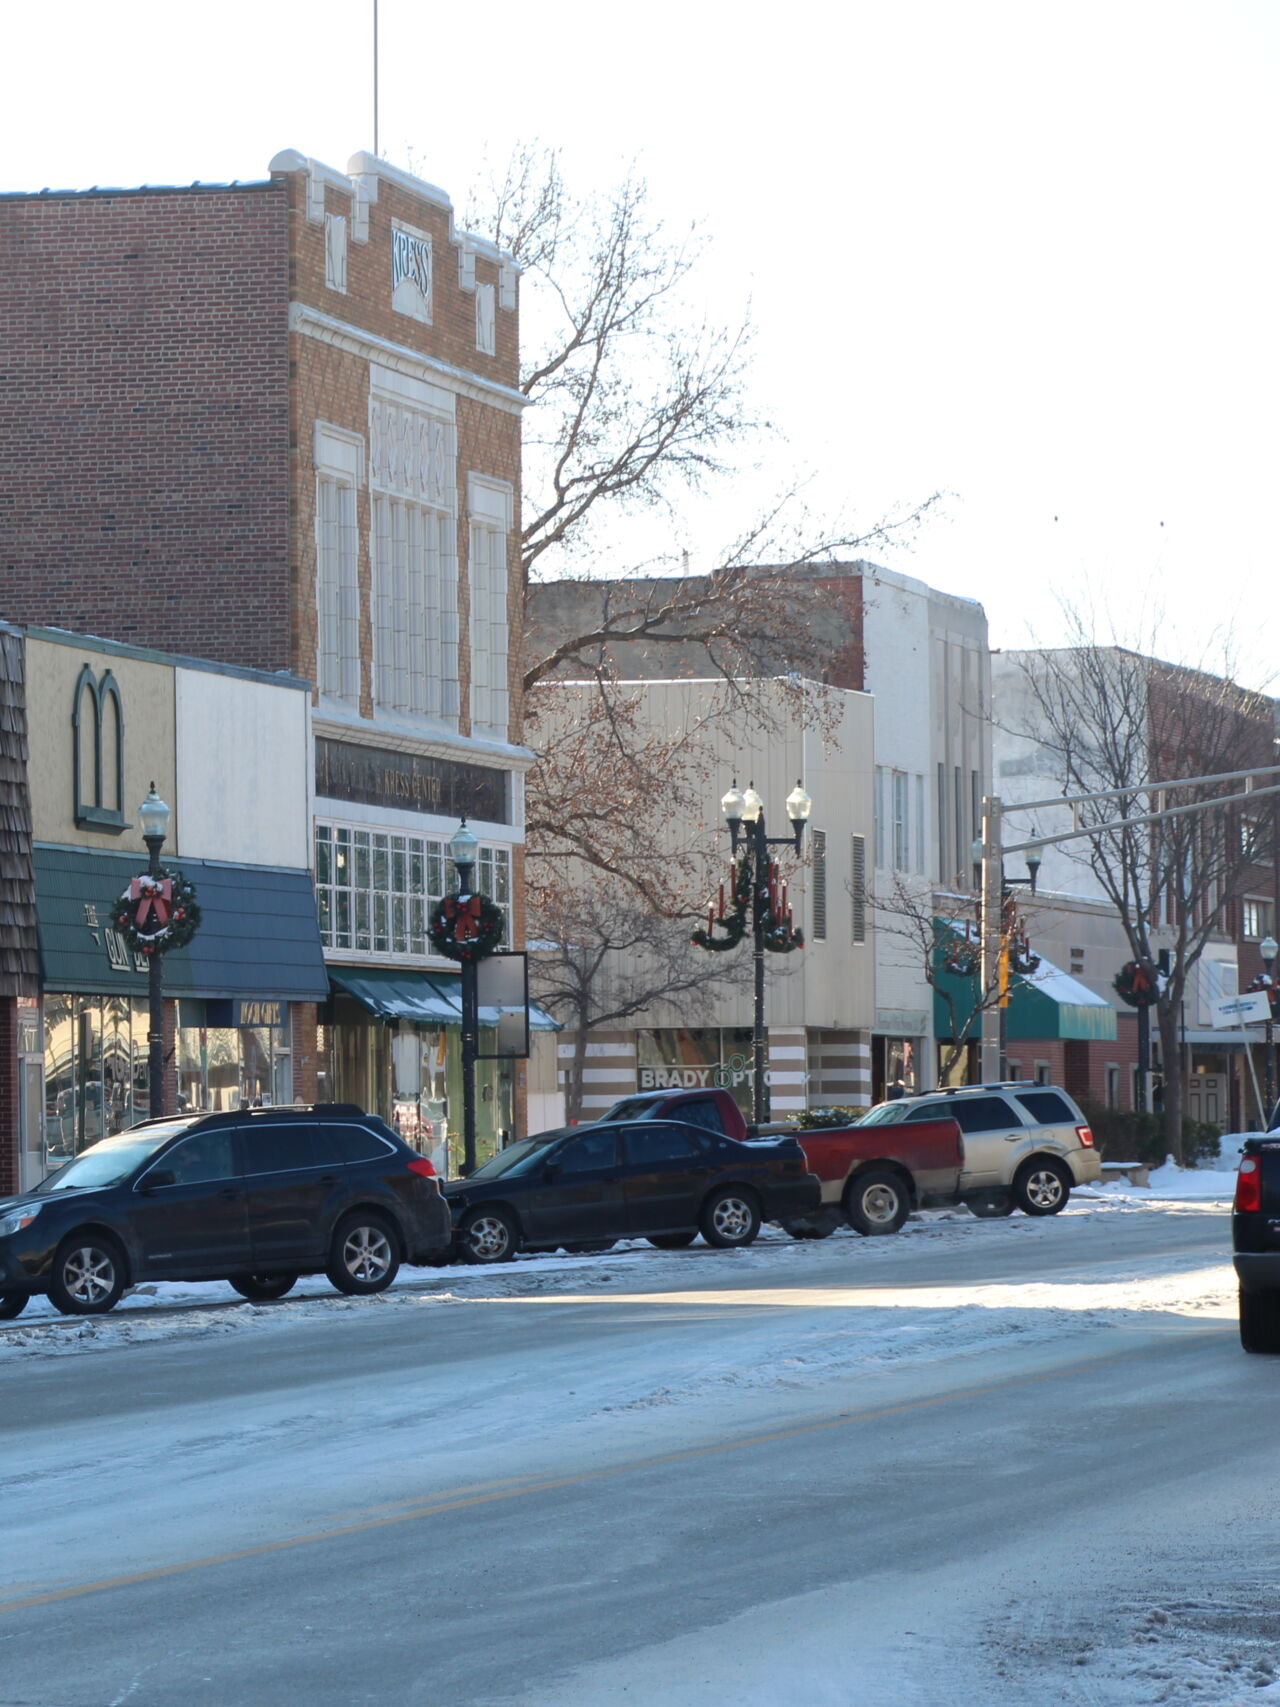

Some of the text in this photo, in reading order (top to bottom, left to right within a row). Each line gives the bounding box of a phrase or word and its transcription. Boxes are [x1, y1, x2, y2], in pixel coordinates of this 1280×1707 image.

[391, 229, 429, 296] KRESS
[384, 769, 441, 803] KRESS CENTER
[84, 904, 99, 925] THE
[641, 1067, 770, 1089] BRADY OPTC
